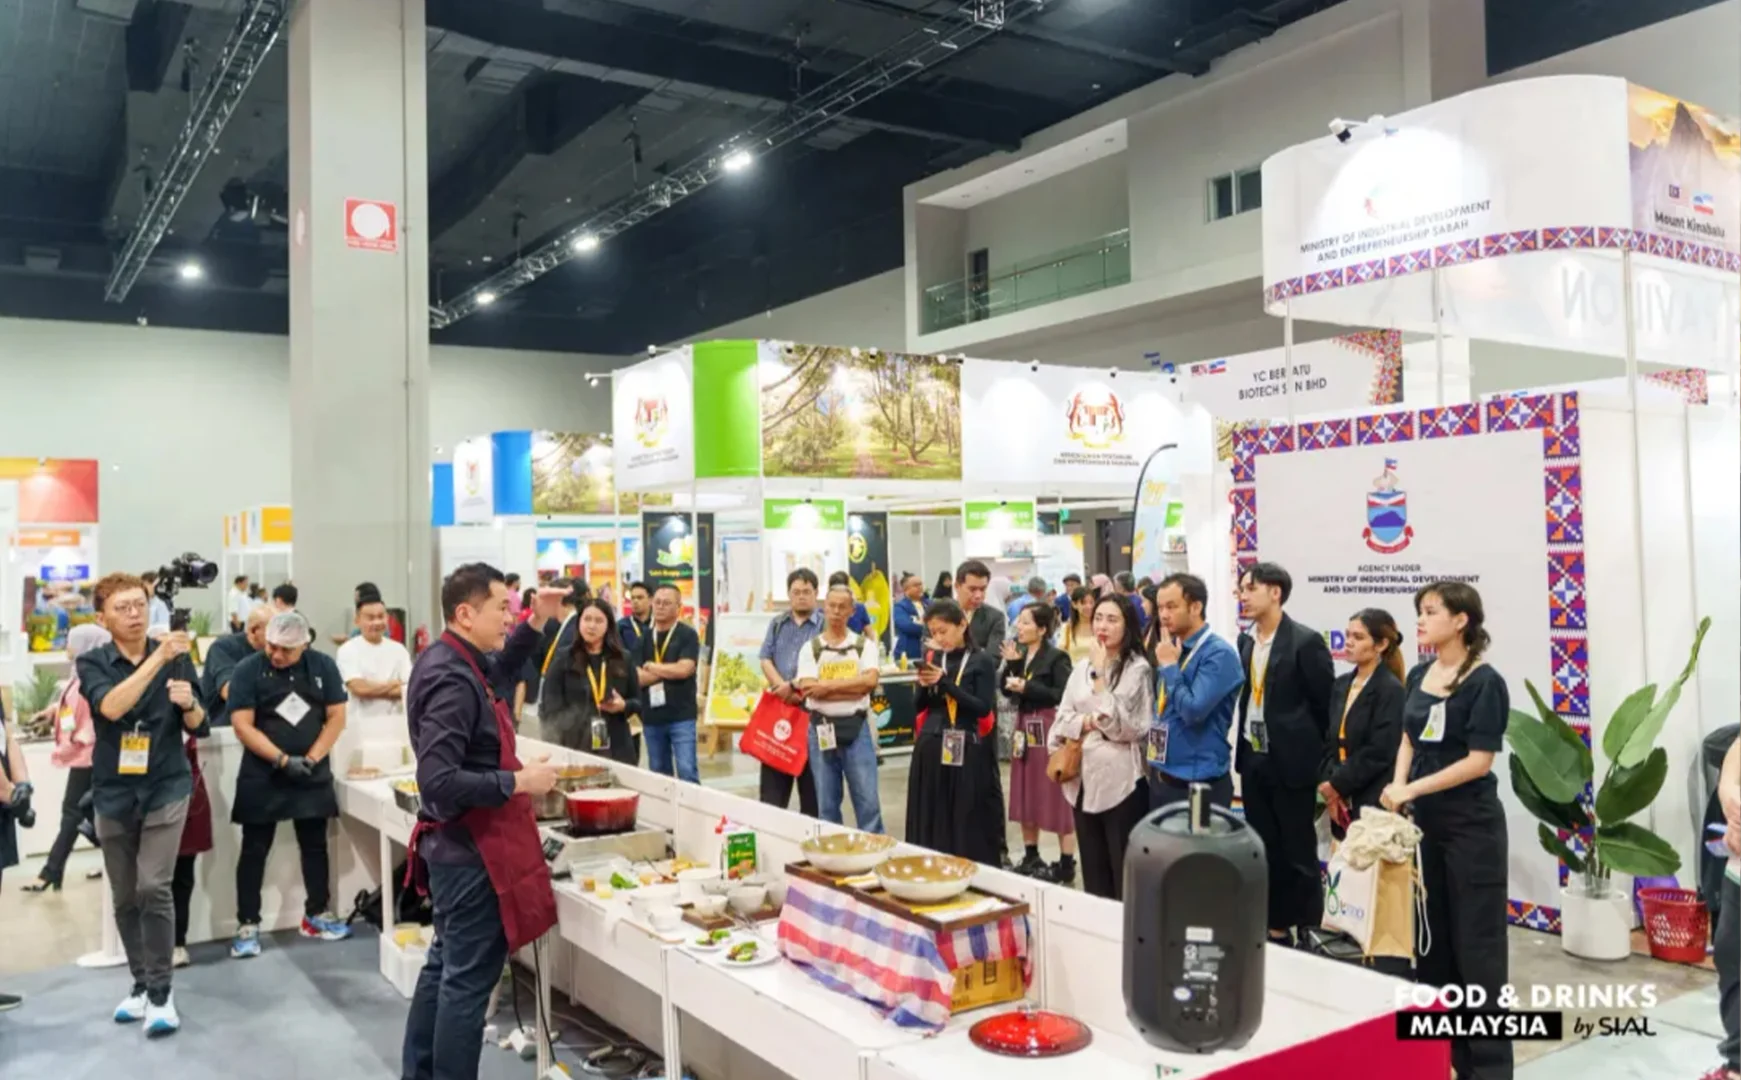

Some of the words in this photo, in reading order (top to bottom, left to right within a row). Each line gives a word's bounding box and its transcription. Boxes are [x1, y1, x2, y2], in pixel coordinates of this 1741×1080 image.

[1300, 235, 1340, 254] MINISTRY
[1342, 231, 1356, 244] OF
[1358, 218, 1411, 240] INDUSTRIAL
[1414, 200, 1491, 227] DEVELOPMENT
[1654, 209, 1685, 229] Mount
[1686, 217, 1726, 238] Kinabalu
[1317, 248, 1338, 262] AND
[1340, 228, 1430, 258] ENTREPRENEURSHIP
[1433, 218, 1469, 237] SABAH
[1253, 370, 1267, 382] YC
[1269, 364, 1311, 381] BERATU
[1238, 385, 1279, 400] BIOTECH
[1281, 381, 1303, 395] SN
[1305, 377, 1328, 390] BHD
[1357, 564, 1390, 573] AGENCY
[1392, 564, 1422, 572] UNDER
[1307, 575, 1345, 583] MINISTRY
[1346, 575, 1357, 583] OF
[1359, 575, 1410, 583] INDUSTRIAL
[1411, 575, 1480, 583] DEVELOPMENT
[1323, 585, 1341, 593] AND
[1342, 585, 1422, 593] ENTREPRENEURSH
